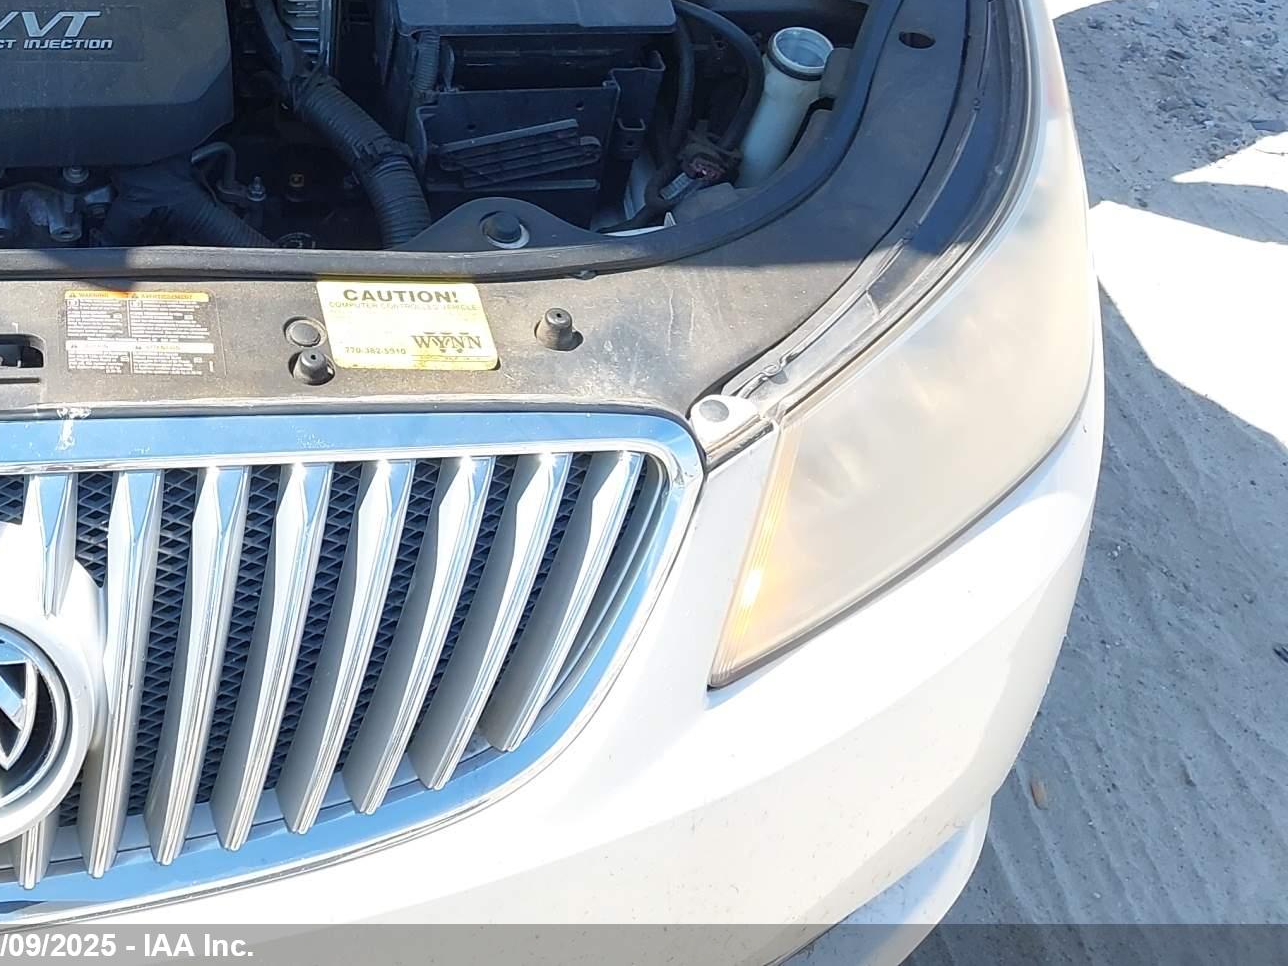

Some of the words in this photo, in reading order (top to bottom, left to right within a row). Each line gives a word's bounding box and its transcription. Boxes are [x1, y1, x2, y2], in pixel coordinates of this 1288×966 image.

[23, 39, 113, 50] INJECTION
[343, 289, 459, 303] CAUTION!
[411, 334, 482, 349] WYNN
